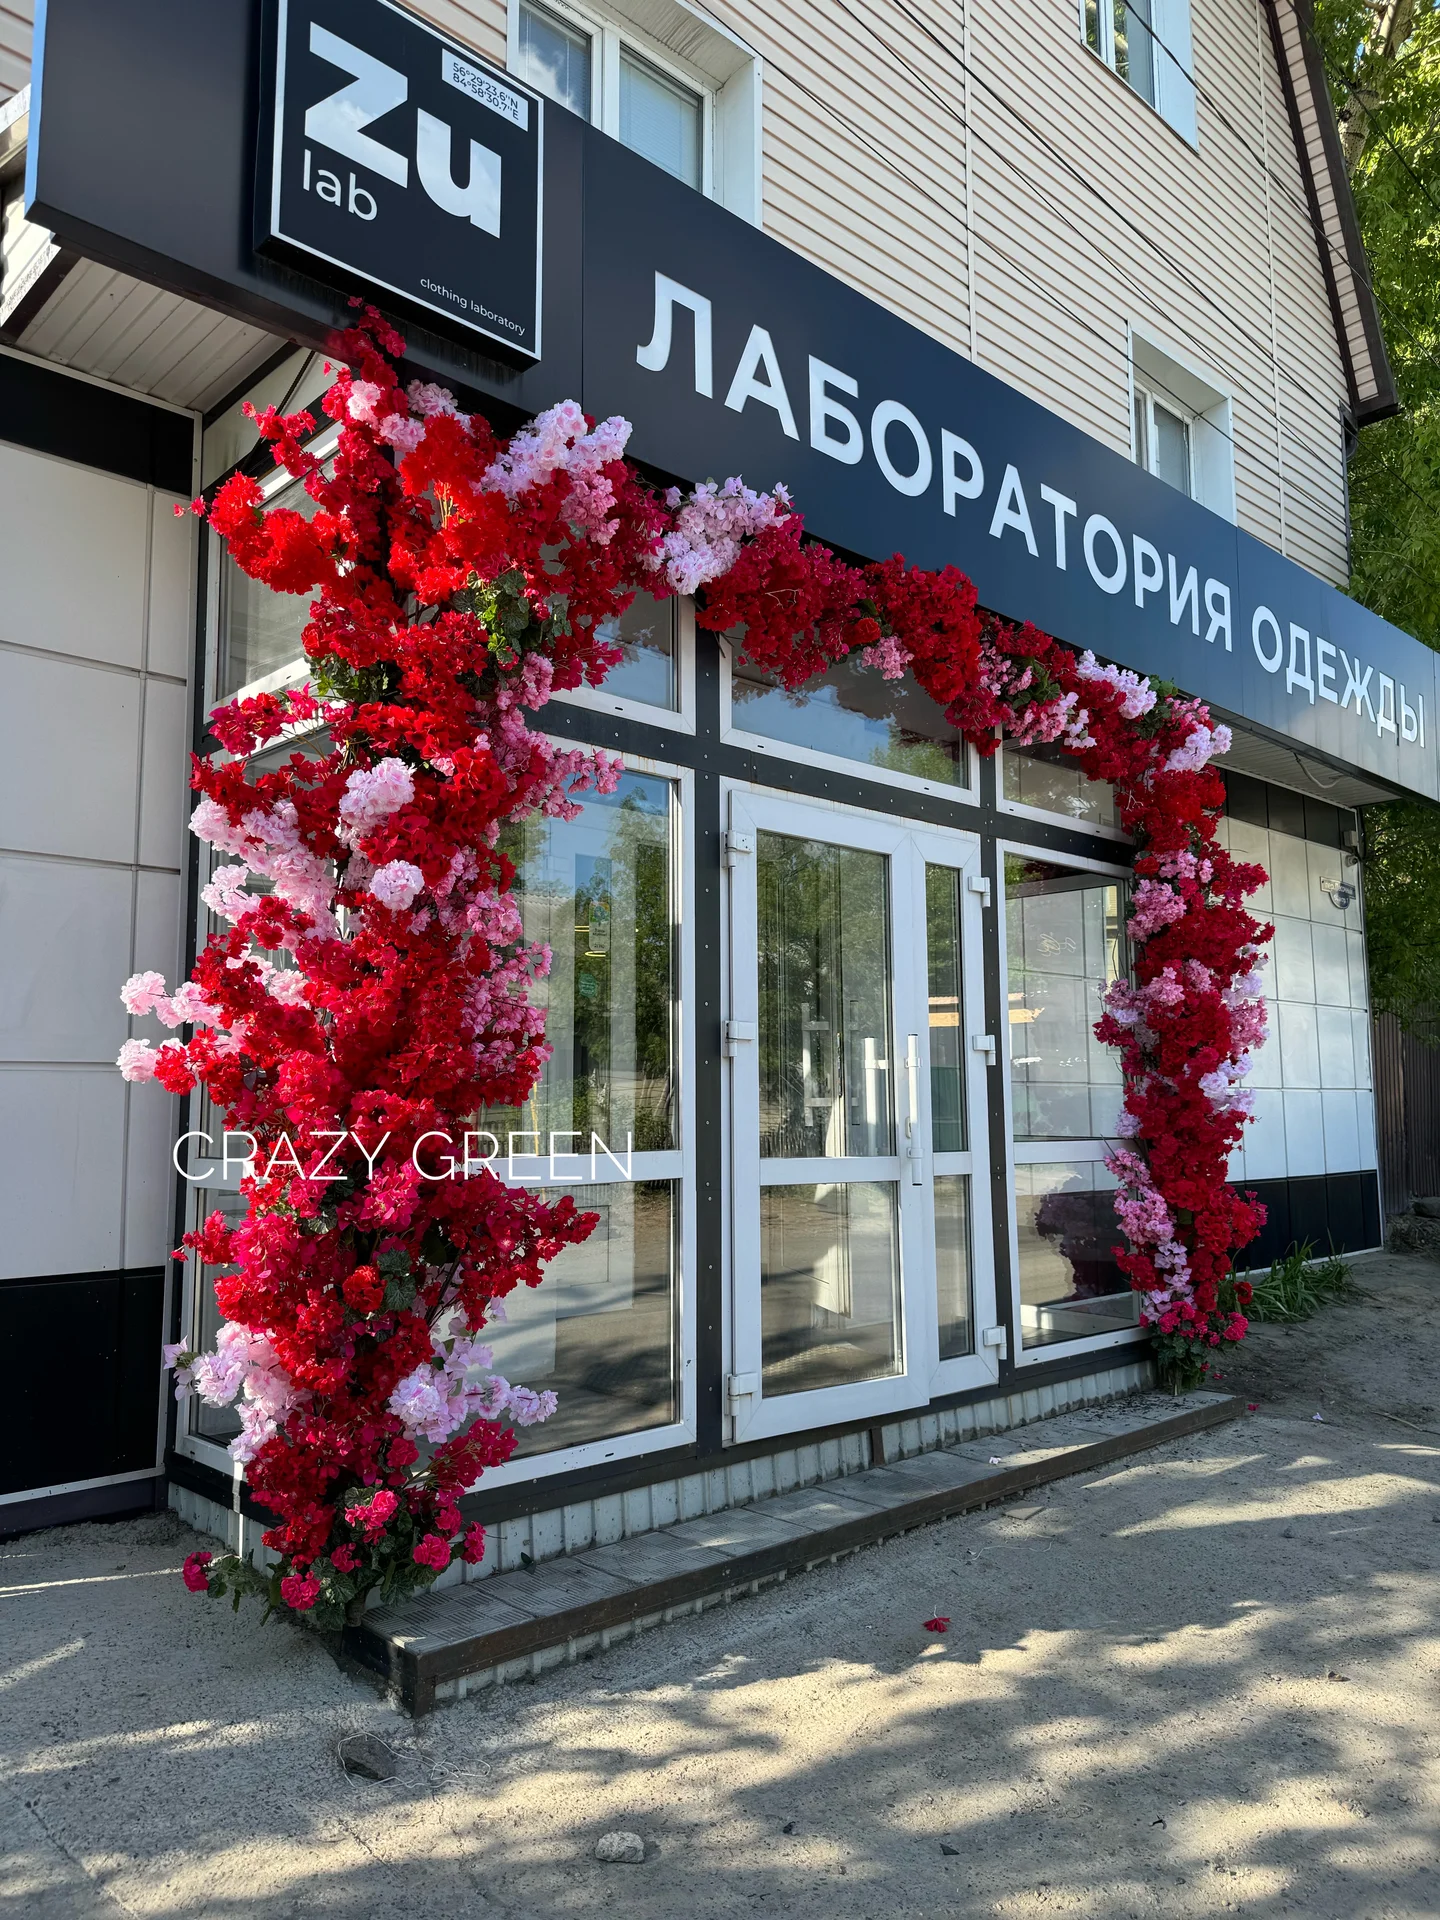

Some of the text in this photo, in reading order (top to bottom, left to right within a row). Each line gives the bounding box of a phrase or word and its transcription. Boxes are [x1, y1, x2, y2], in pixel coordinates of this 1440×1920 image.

[303, 148, 378, 221] lab
[304, 21, 502, 239] Zu
[420, 278, 526, 336] clothing laboratory
[636, 270, 1426, 749] ЛАБОРАТОРИЯ ОДЕЖДЫ
